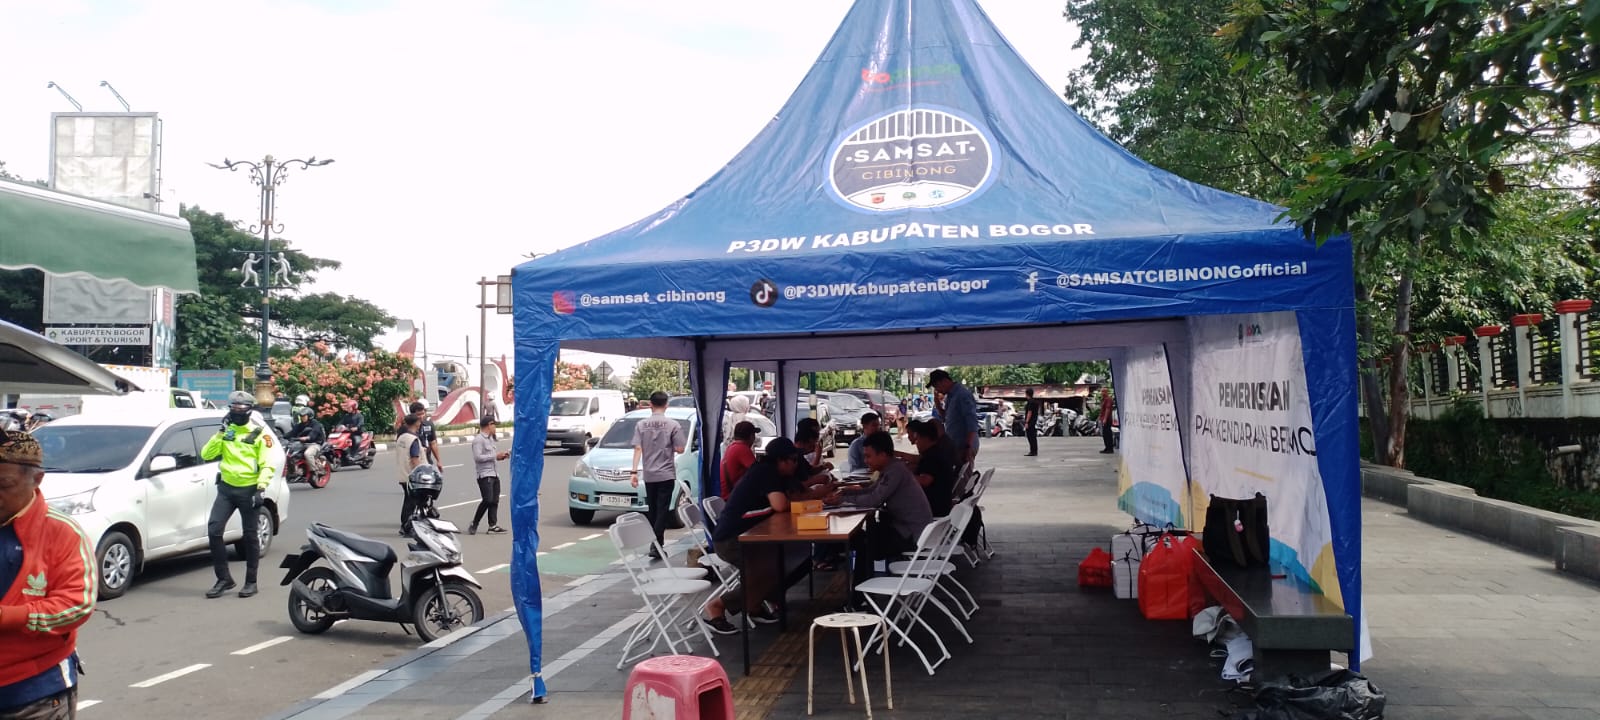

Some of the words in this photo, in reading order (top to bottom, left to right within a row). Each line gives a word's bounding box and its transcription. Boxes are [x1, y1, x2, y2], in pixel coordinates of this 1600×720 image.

[862, 165, 957, 181] CIBINONG
[727, 236, 806, 254] P3DW
[812, 222, 980, 249] KABUPATEN
[989, 223, 1096, 238] BOGOR
[1056, 261, 1308, 289] @SAMSATCIBINONGofficial
[580, 290, 726, 307] @samsat_cibinong
[784, 278, 990, 300] @P3DWKabupatenBogor
